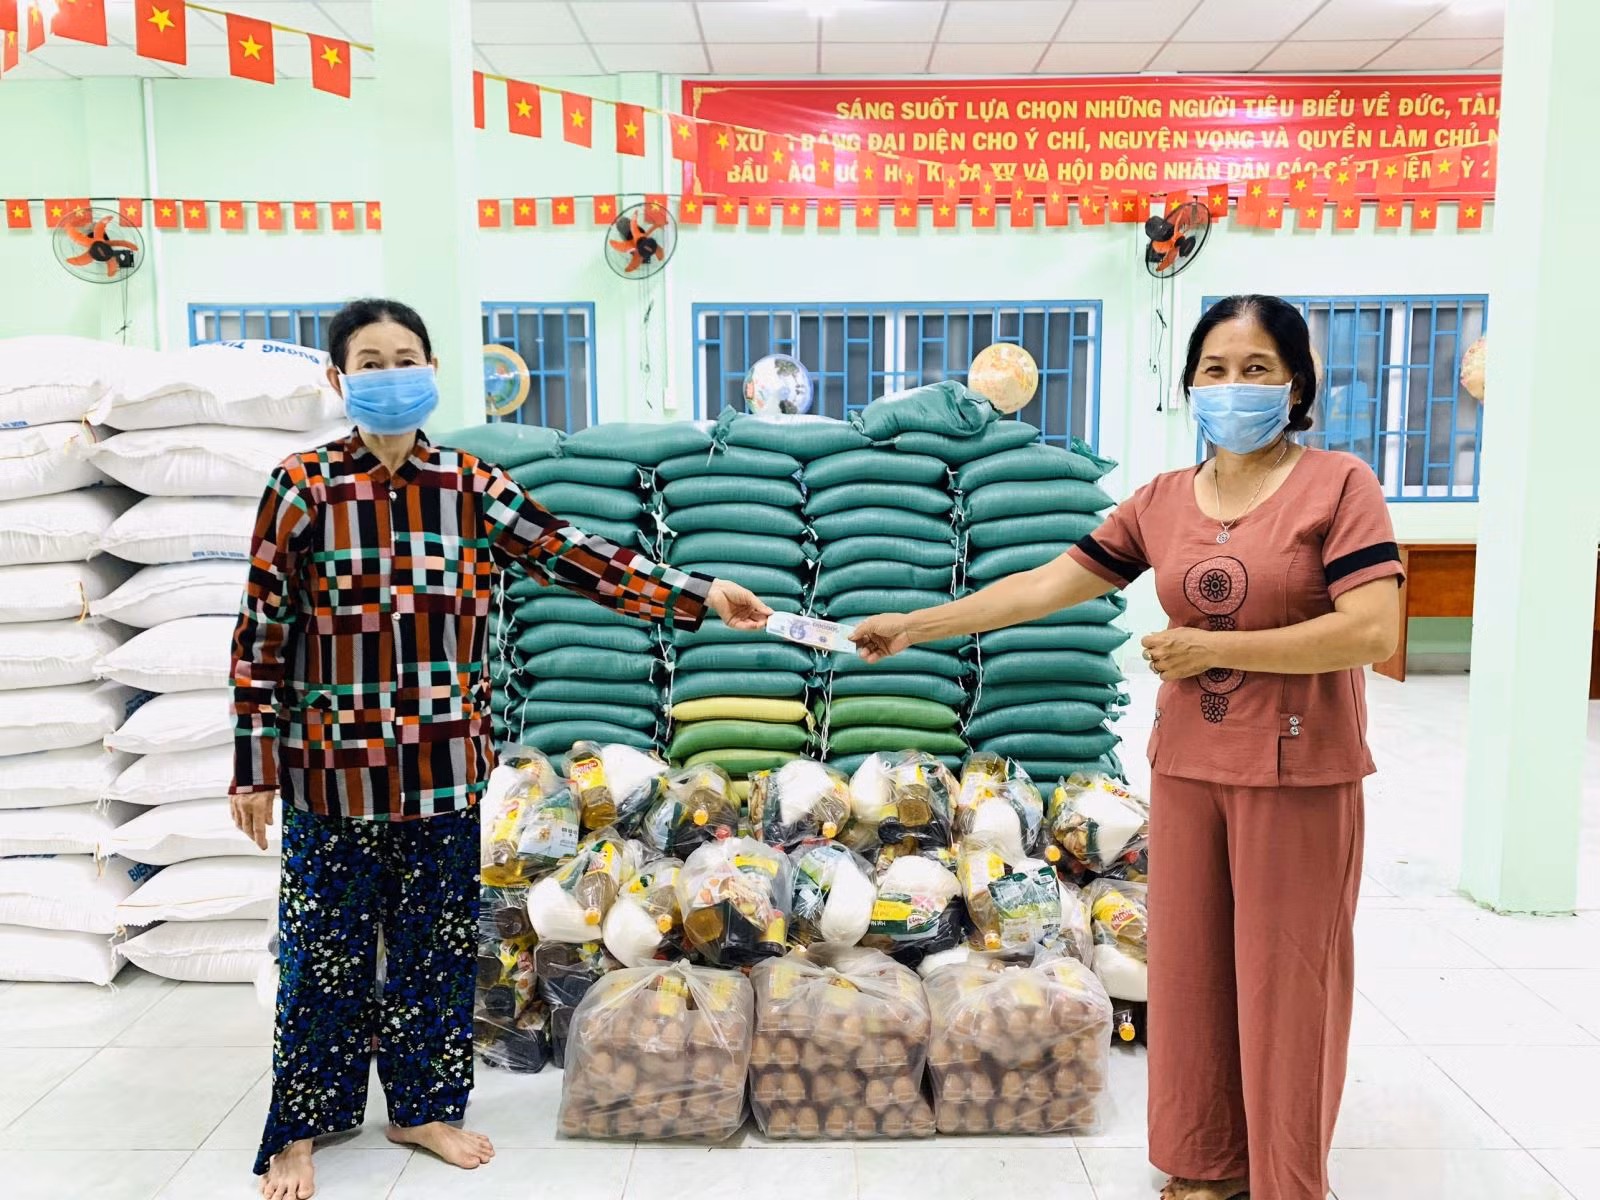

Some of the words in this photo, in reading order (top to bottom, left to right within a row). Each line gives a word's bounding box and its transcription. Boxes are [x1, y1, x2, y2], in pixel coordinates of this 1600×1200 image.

[836, 97, 894, 120] SÁNG
[901, 95, 958, 120] SUỐT
[966, 98, 1009, 123] LỰA
[1016, 101, 1078, 123] CHỌN
[1086, 95, 1161, 119] NHỮNG
[1168, 95, 1236, 118] NGƯỜI
[1243, 95, 1294, 117] TIÊU
[1302, 89, 1355, 117] BIỂU
[1362, 91, 1390, 117] VỀ
[1398, 92, 1452, 120] ĐỨC,
[867, 133, 905, 155] ĐẠI
[912, 128, 966, 155] DIỆN
[972, 132, 1018, 151] CHO
[1025, 127, 1039, 150] Ý
[1047, 127, 1091, 153] CHÍ,
[1099, 126, 1188, 153] NGUYỆN
[1195, 130, 1254, 152] VỌNG
[1261, 126, 1289, 149] VÀ
[1297, 122, 1372, 151] QUYỀN
[1379, 125, 1428, 149] LÀM
[1434, 121, 1480, 148] CHỦ
[1023, 157, 1049, 181] VÀ
[1058, 158, 1093, 184] HỘI
[1100, 154, 1157, 180] ĐỒNG
[1164, 157, 1221, 180] NHÂN
[1227, 157, 1270, 179] DÂN
